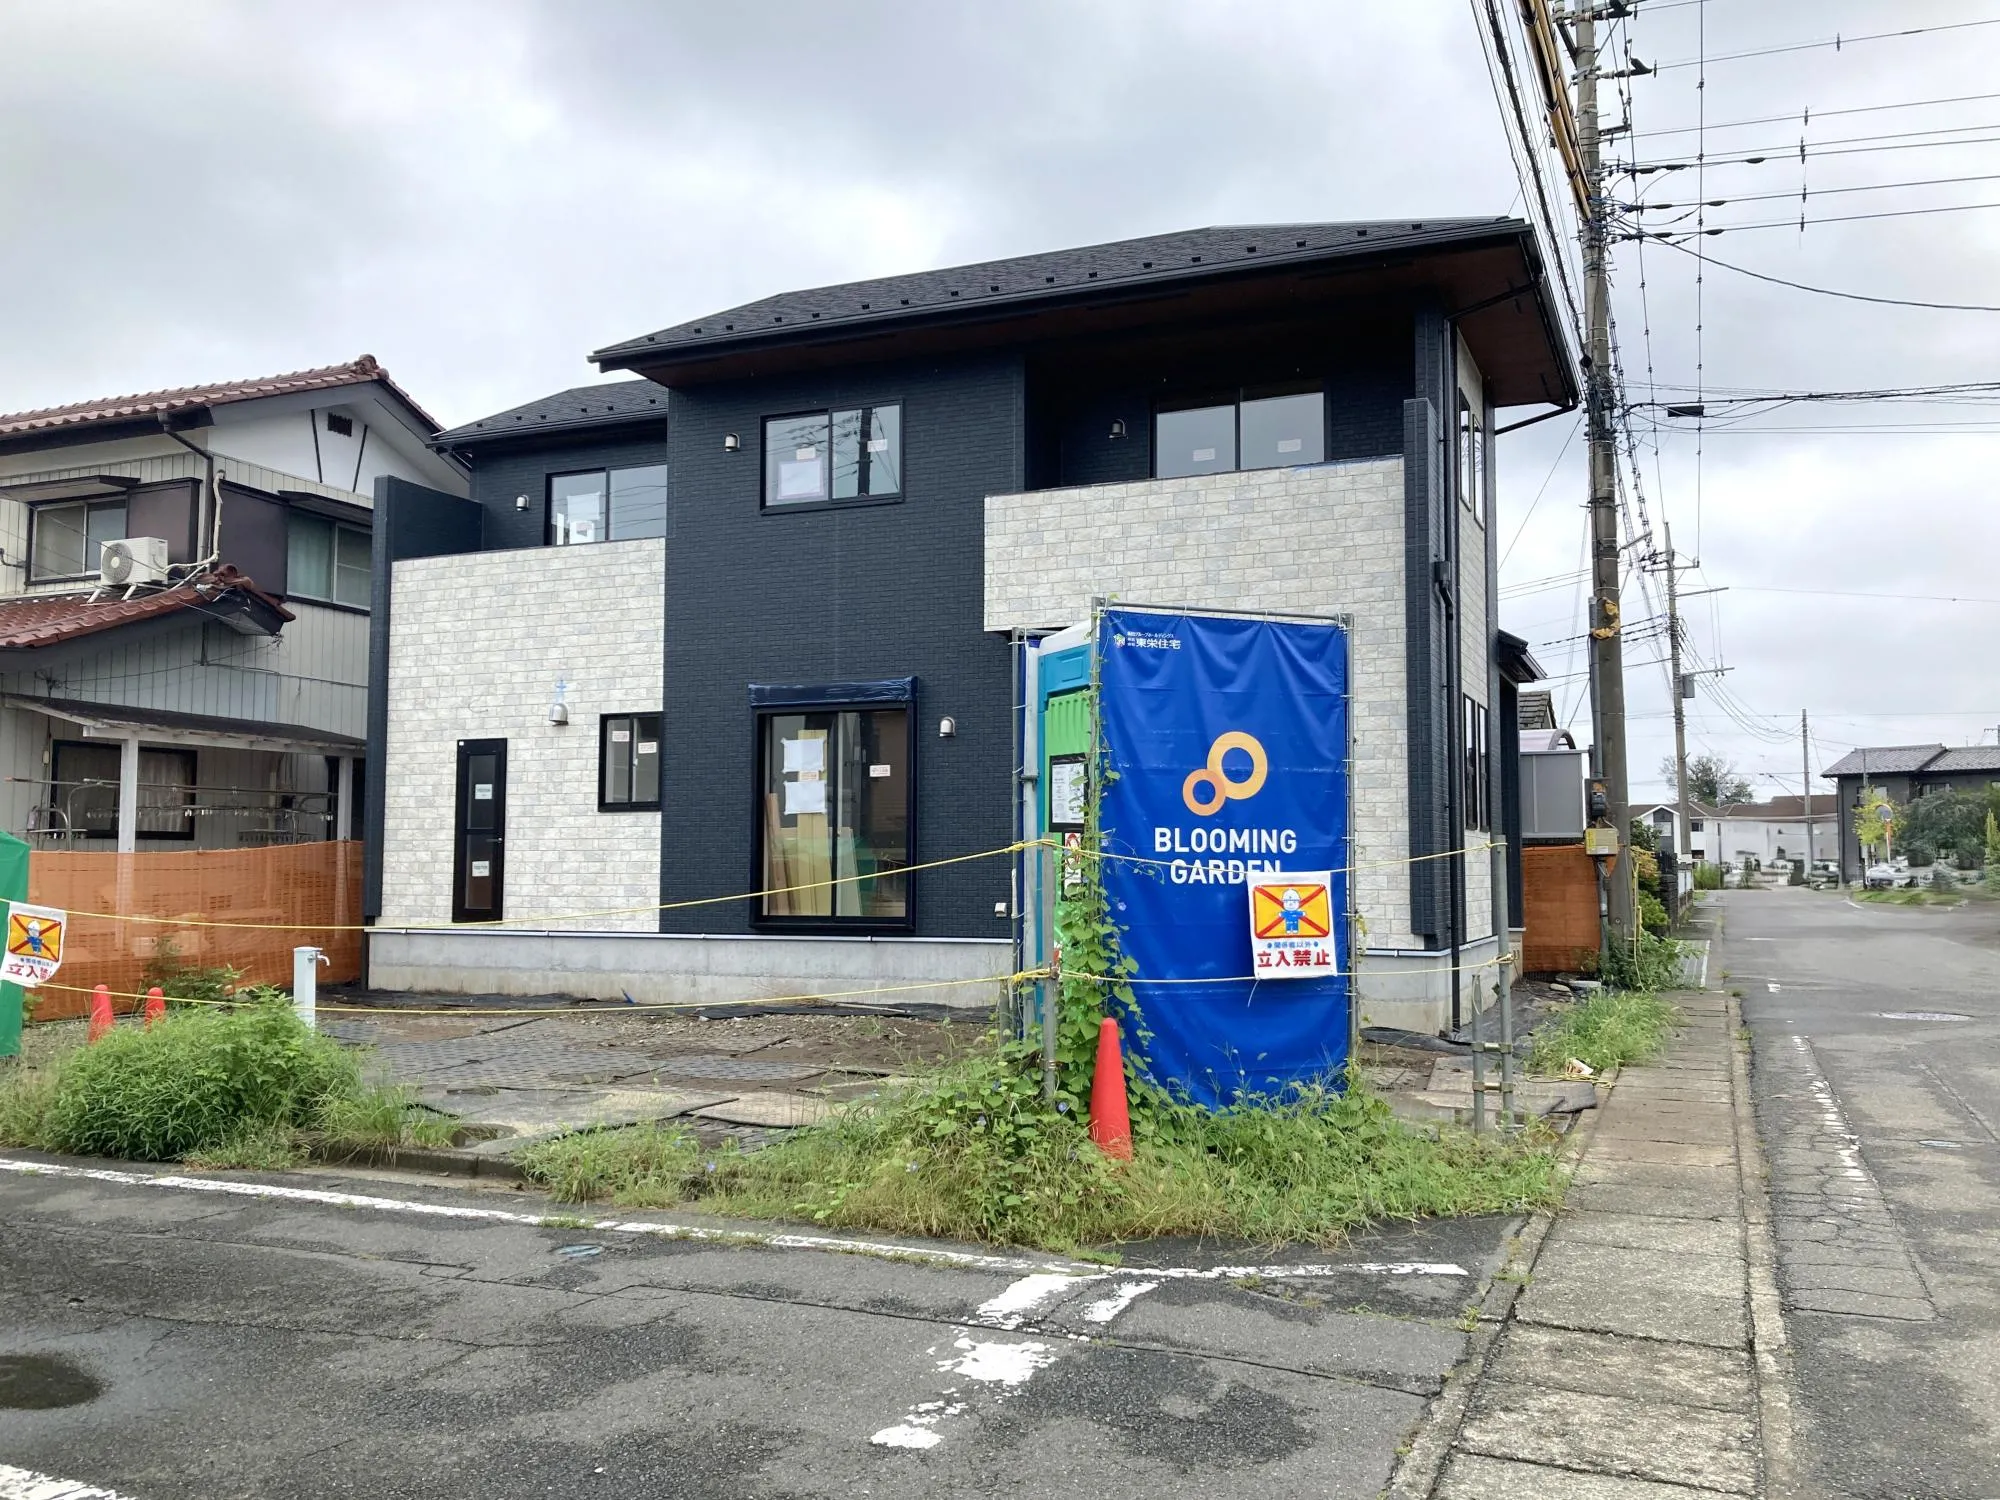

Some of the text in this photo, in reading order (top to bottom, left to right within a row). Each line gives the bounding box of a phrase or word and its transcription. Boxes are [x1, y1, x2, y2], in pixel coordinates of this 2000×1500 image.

[1136, 638, 1181, 650] 東栄住宅
[1154, 827, 1297, 854] BLOOMING
[1257, 949, 1331, 968] 立入禁止
[5, 963, 53, 980] 立入禁
